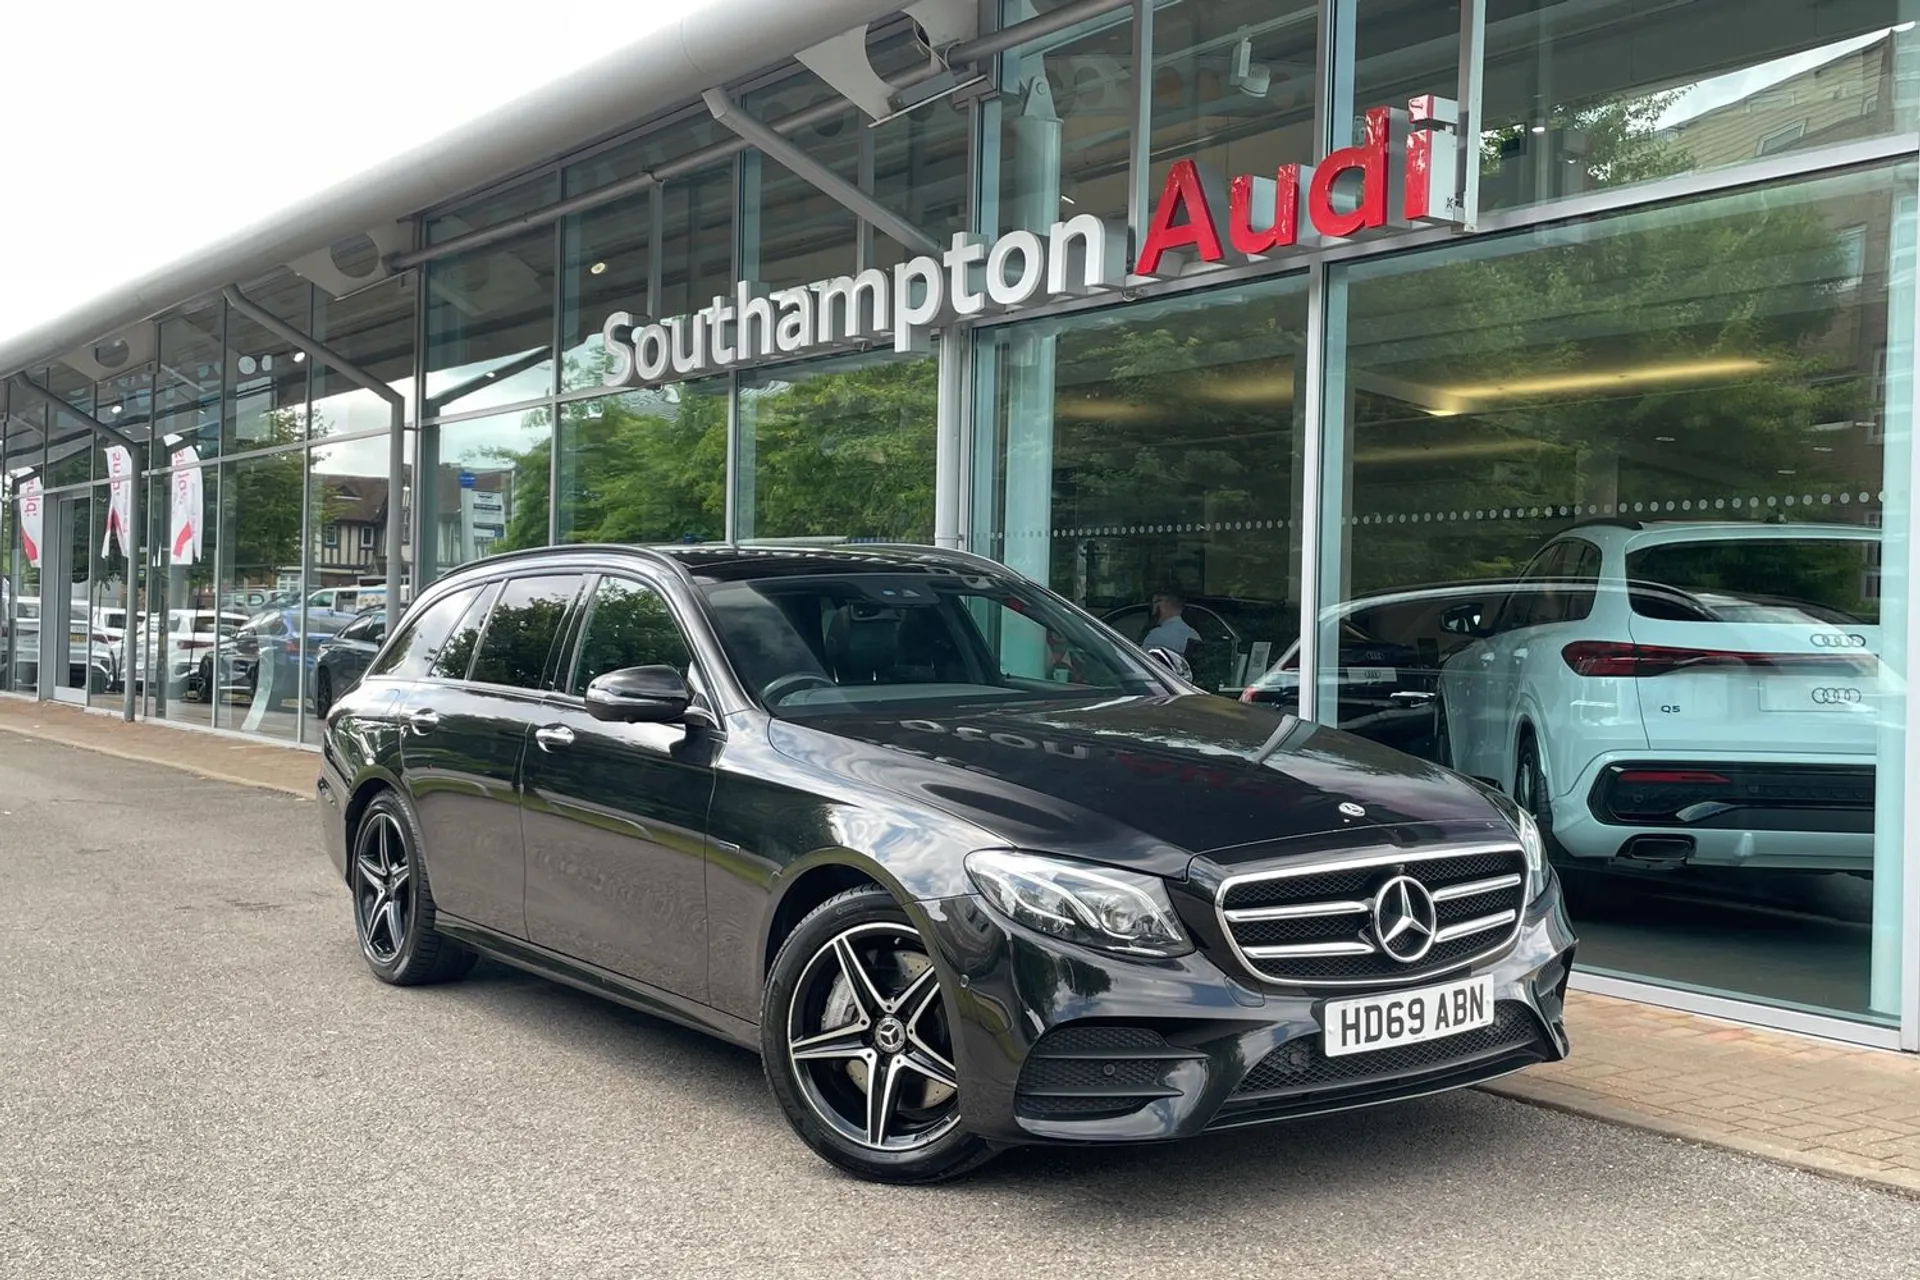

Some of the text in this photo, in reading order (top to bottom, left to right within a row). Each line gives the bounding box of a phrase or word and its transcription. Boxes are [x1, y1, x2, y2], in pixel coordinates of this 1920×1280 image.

[602, 94, 1432, 388] Southampton Audi
[1660, 704, 1681, 714] Q5
[1341, 983, 1484, 1047] HD69 ABN
